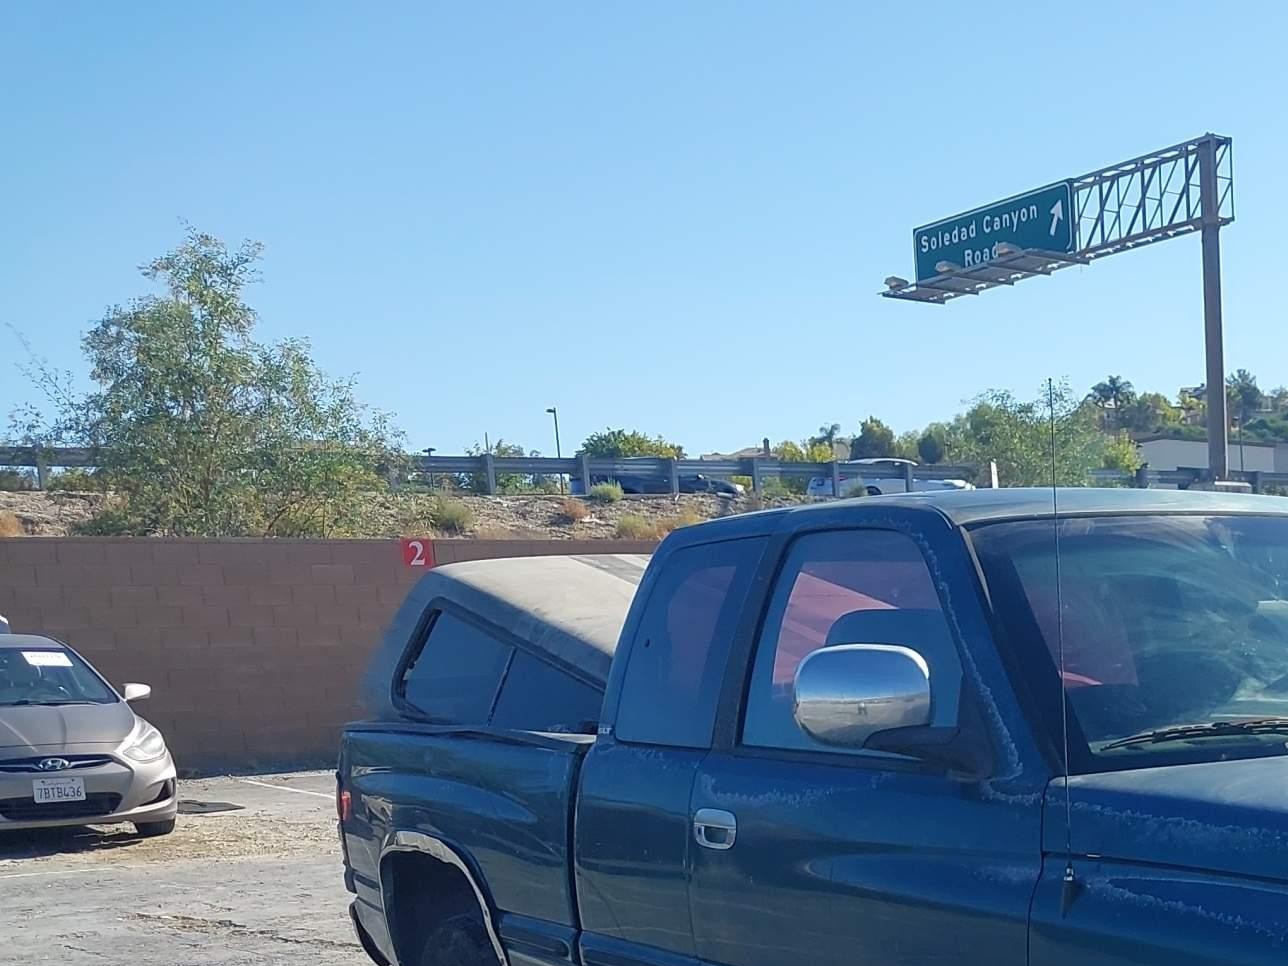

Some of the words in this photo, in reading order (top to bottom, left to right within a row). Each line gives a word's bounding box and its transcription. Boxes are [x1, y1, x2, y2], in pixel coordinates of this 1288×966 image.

[921, 220, 977, 252] Soledad
[983, 204, 1037, 232] Canyon
[964, 241, 999, 267] Road
[409, 541, 426, 566] 2
